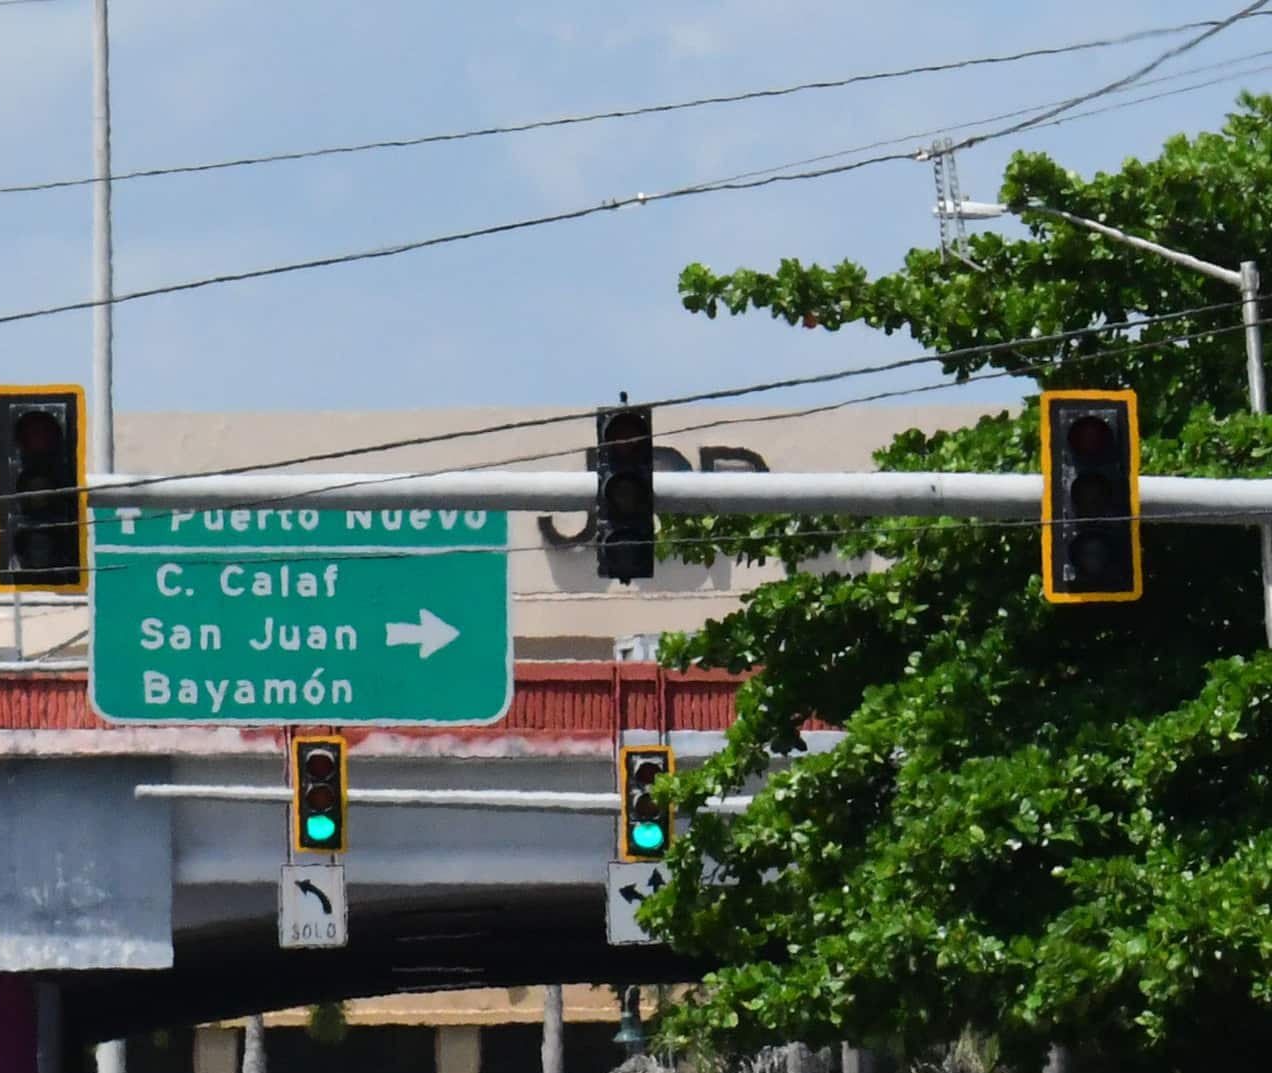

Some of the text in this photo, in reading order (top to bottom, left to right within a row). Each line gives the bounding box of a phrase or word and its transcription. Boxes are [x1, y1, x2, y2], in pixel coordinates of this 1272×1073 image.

[170, 508, 487, 532] Puerto Nuevo
[156, 562, 339, 598] C. Calaf
[140, 617, 357, 651] San Juan
[143, 667, 353, 713] Bayamón
[291, 922, 337, 941] SOLO
